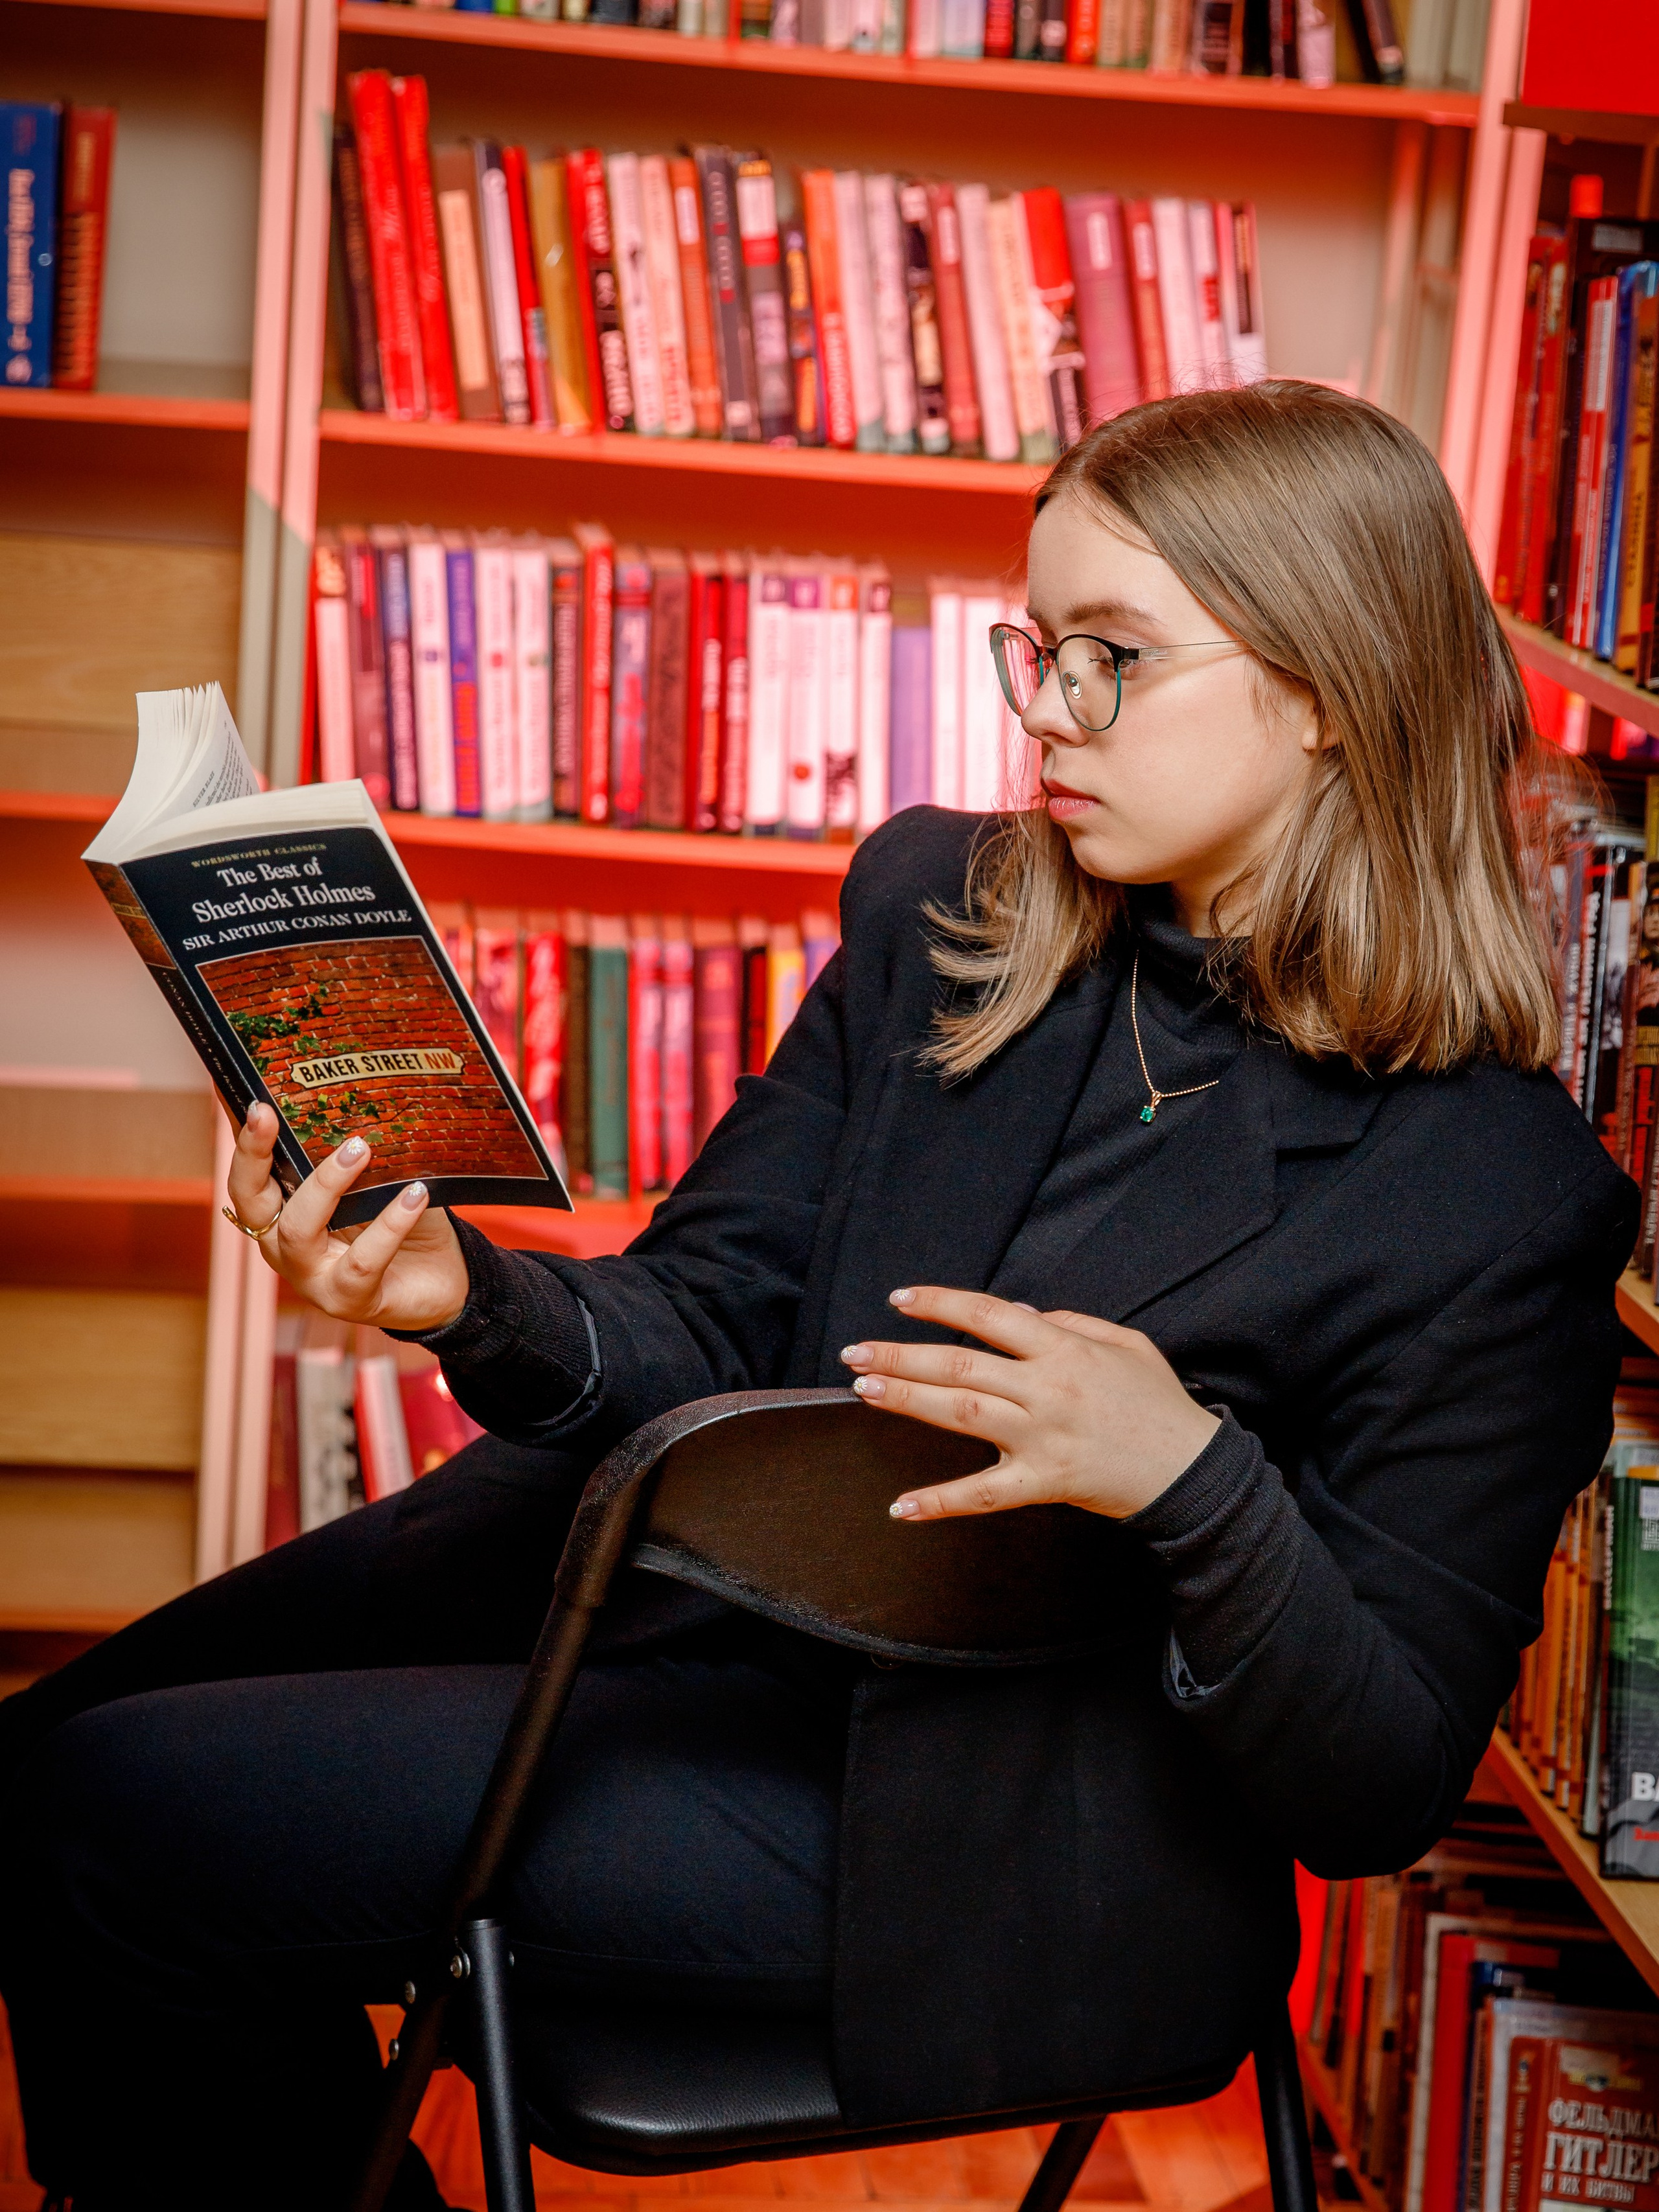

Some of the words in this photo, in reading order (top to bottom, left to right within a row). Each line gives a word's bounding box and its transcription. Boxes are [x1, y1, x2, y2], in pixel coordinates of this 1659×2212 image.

[191, 847, 272, 868] WORDSWORTH
[273, 843, 327, 855] CLASSICS
[216, 867, 257, 887] The
[257, 863, 301, 881] Best
[303, 856, 323, 875] of
[192, 888, 294, 923] Sherlock
[292, 882, 375, 906] Holmes
[182, 934, 215, 950] SIR
[218, 919, 291, 943] ARTHUR
[291, 912, 352, 930] CONAN
[354, 909, 412, 925] DOYLE
[299, 1058, 360, 1082] BAKER
[360, 1054, 423, 1072] STREET
[424, 1053, 456, 1069] NW
[1541, 2171, 1554, 2193] И
[1558, 2174, 1580, 2196] ИХ
